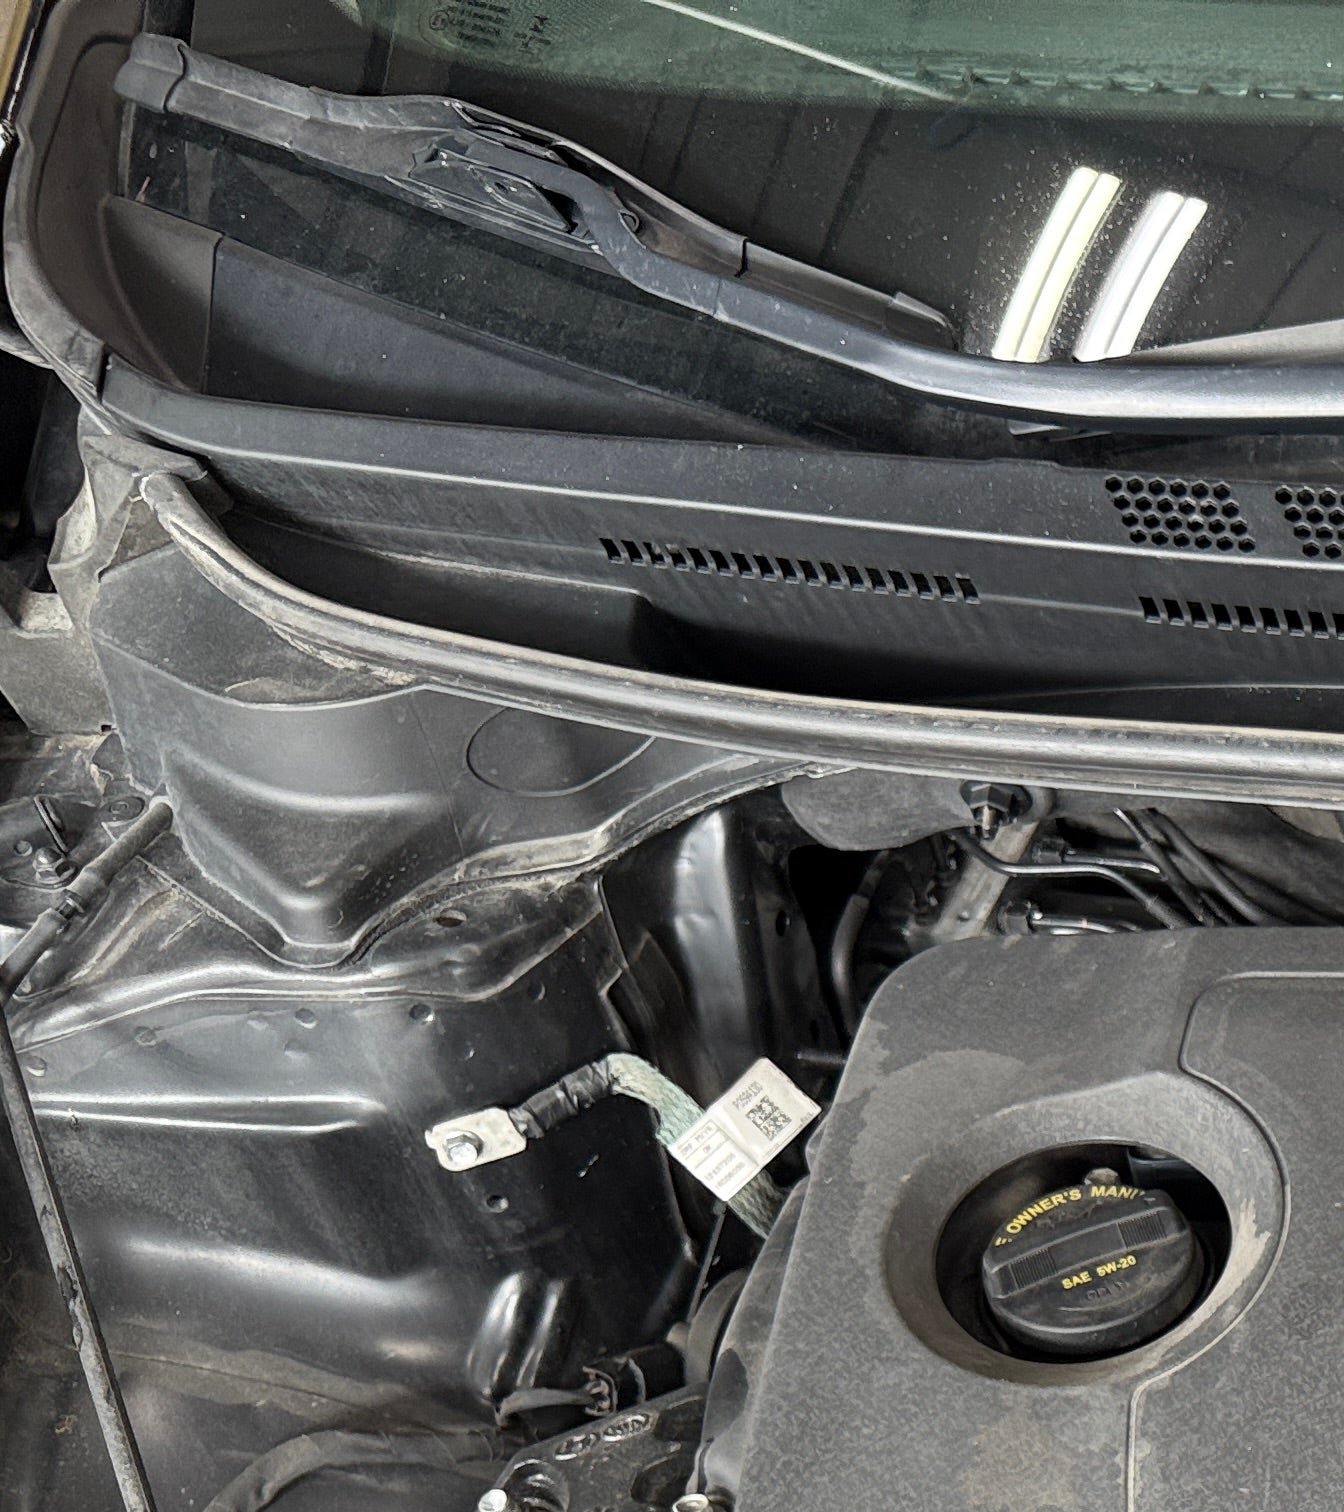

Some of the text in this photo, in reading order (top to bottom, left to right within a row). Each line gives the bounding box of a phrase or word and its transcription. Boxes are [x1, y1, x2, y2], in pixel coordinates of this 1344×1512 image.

[1006, 1187, 1082, 1235] OWNER'S
[1061, 1254, 1137, 1290] SAE 5W-20
